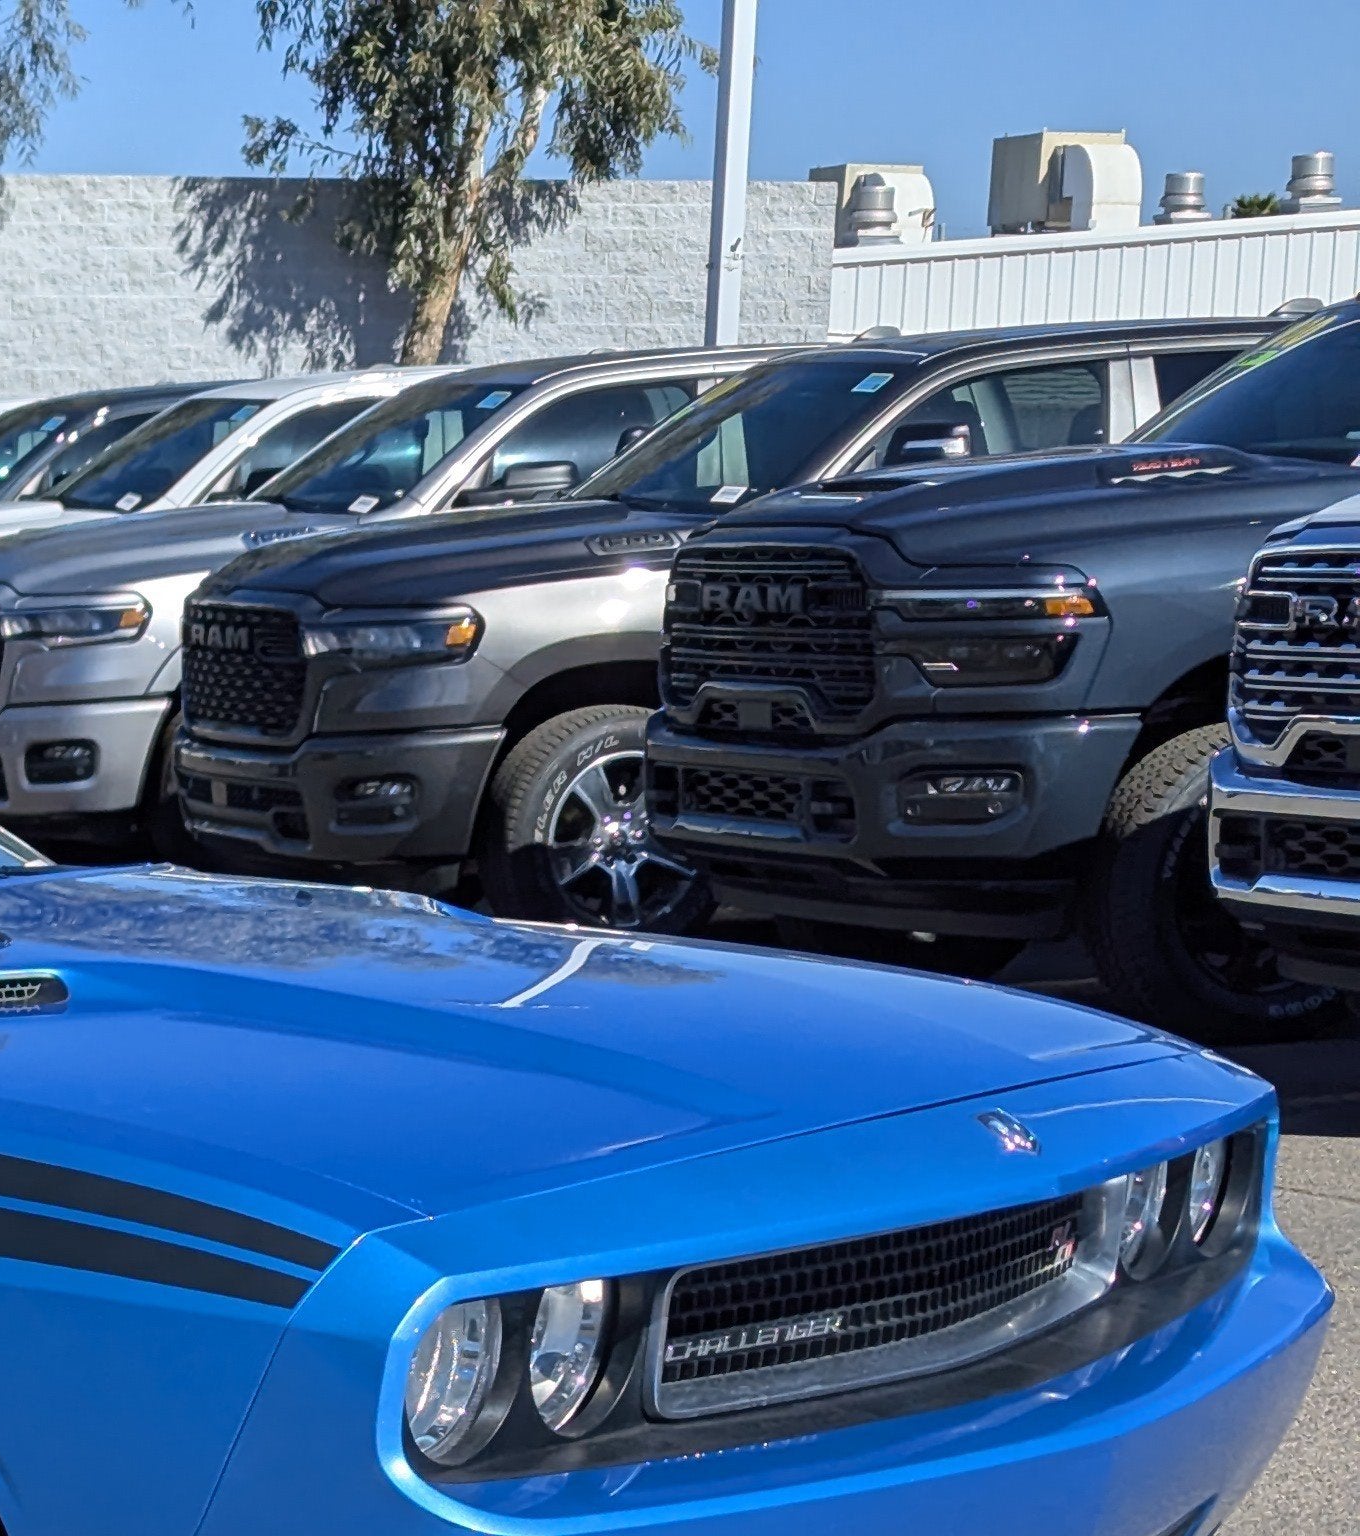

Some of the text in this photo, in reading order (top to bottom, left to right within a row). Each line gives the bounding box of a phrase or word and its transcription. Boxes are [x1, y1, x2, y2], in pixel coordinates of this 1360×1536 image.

[703, 583, 805, 613] RAM
[189, 624, 250, 650] RAM
[664, 1314, 846, 1363] CHALLENGER
